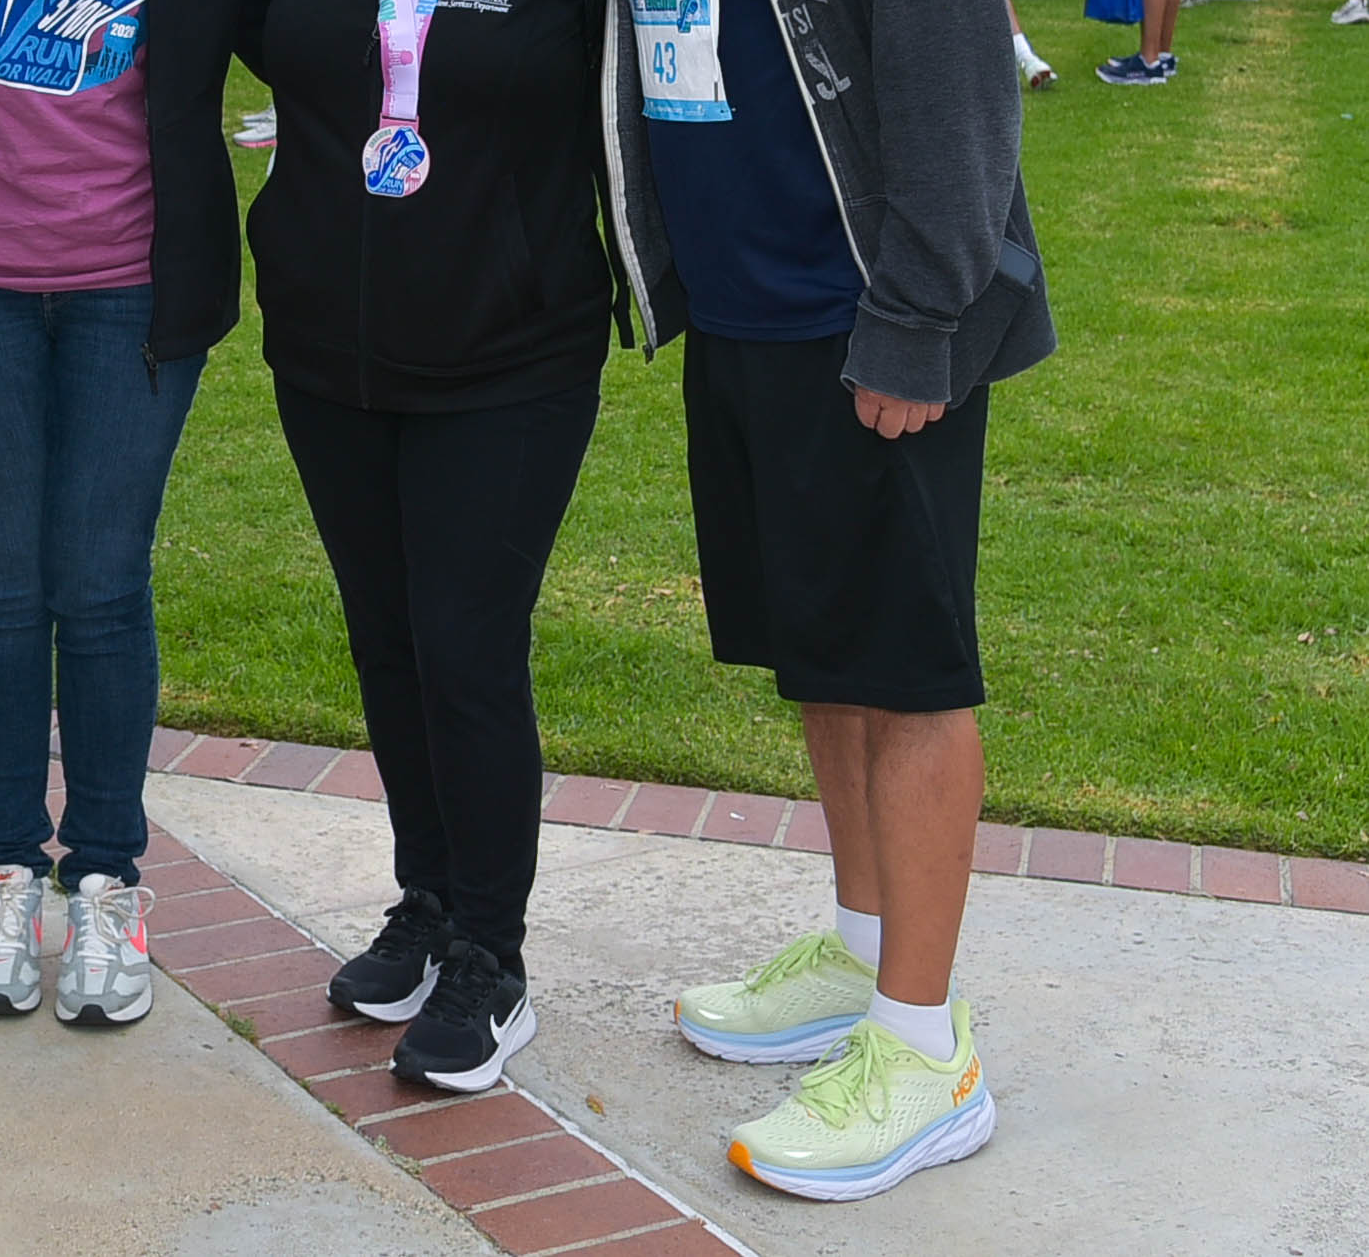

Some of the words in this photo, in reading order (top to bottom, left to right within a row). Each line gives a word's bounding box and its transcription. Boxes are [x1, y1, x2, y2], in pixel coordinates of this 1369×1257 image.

[10, 34, 83, 71] RUN
[653, 41, 677, 84] 43
[24, 64, 78, 88] WALK
[951, 1054, 980, 1109] HOKA
